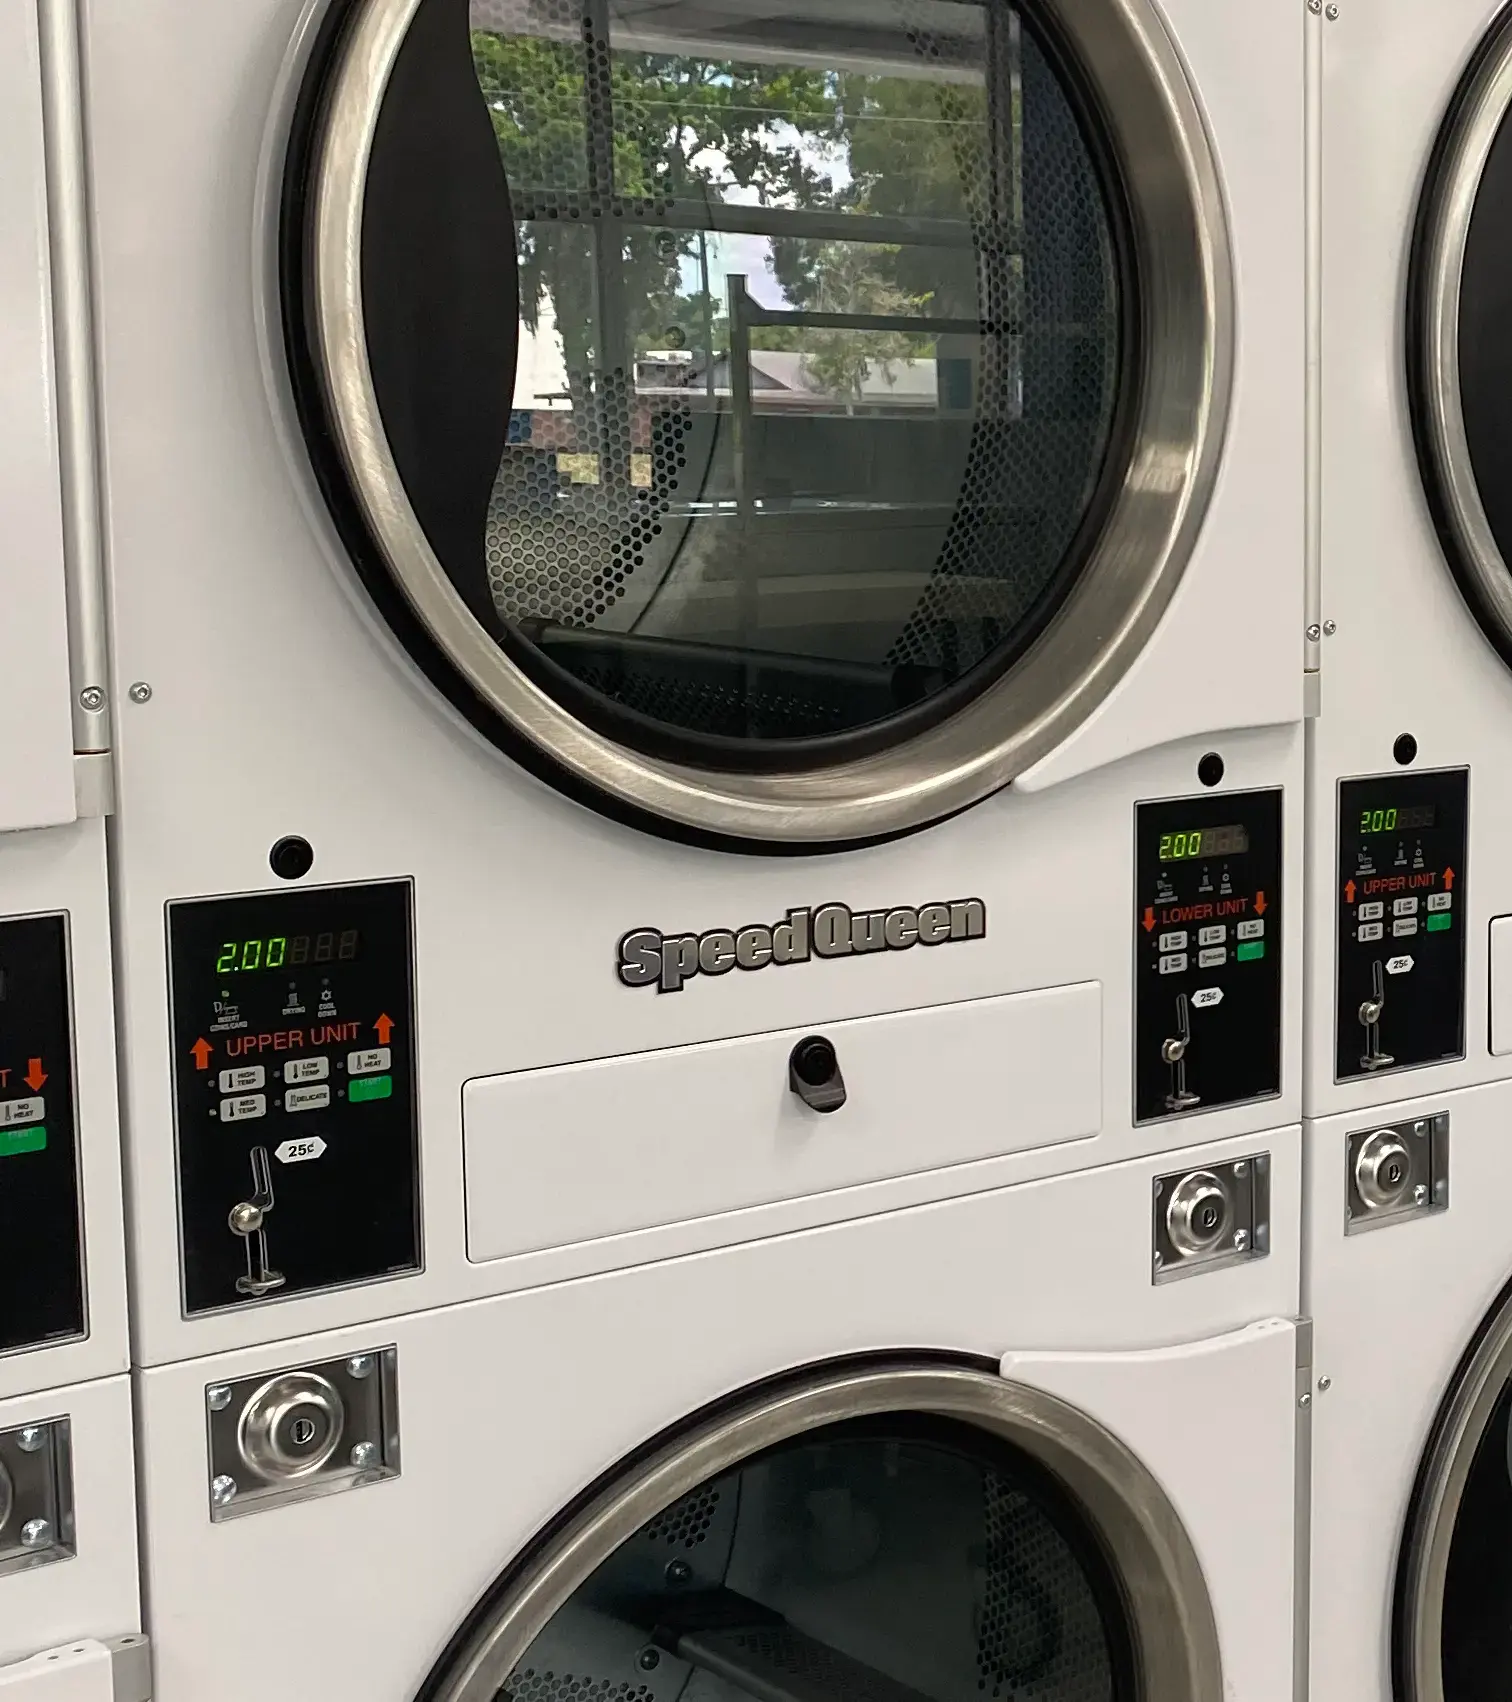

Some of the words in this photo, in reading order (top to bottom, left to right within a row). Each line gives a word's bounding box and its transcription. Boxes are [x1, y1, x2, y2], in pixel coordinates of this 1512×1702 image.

[1364, 876, 1406, 895] UPPER
[1409, 872, 1437, 889] UNIT
[1162, 903, 1213, 924] LOWER
[1216, 898, 1249, 916] UNIT
[216, 937, 287, 973] 2.00
[226, 1030, 304, 1057] UPPER
[310, 1022, 361, 1046] UNIT
[301, 1069, 320, 1077] TEMP
[302, 1062, 318, 1070] LOW
[236, 1077, 257, 1086] TEMP
[288, 1142, 315, 1158] 25¢
